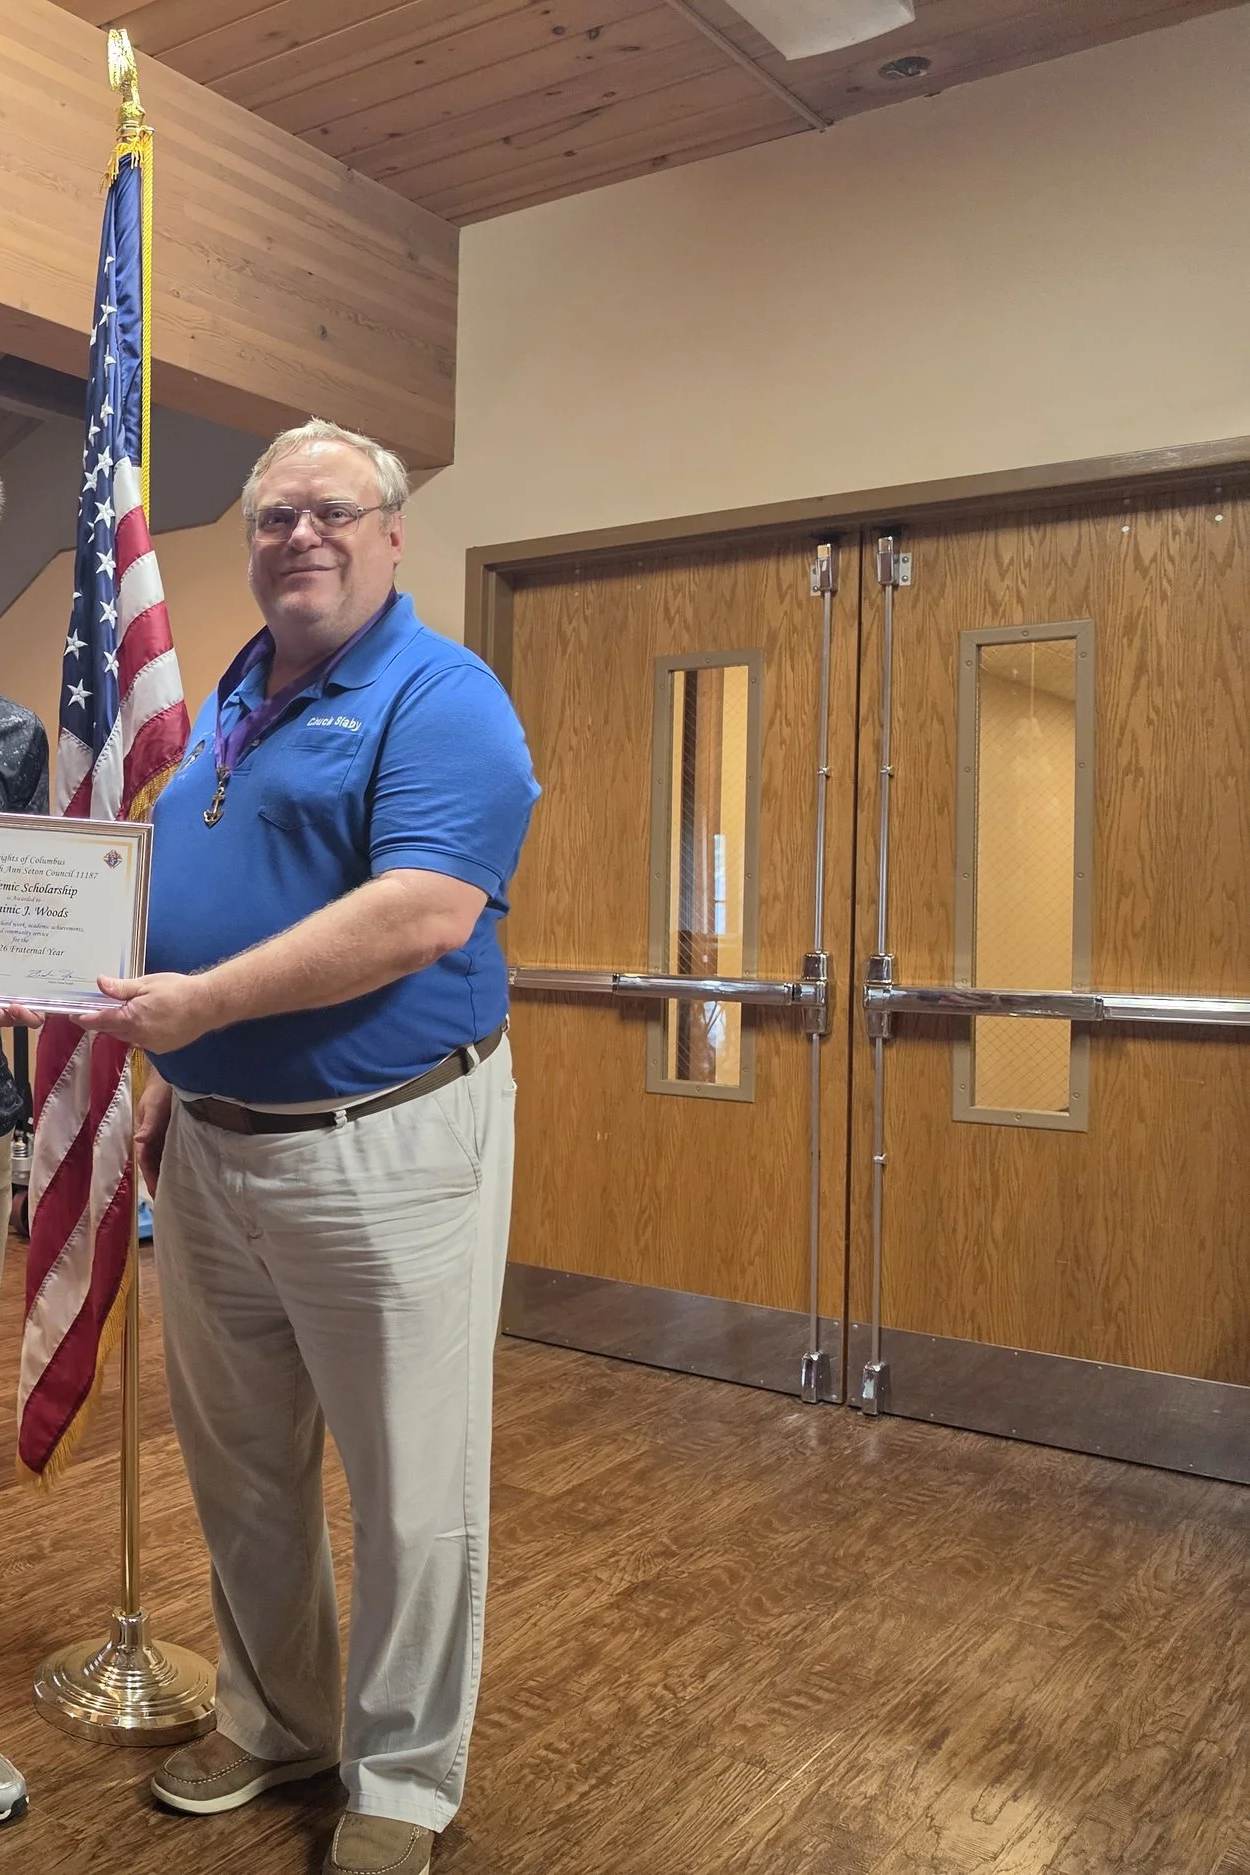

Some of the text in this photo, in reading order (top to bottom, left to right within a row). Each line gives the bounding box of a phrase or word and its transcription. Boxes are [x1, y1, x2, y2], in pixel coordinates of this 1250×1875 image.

[20, 855, 30, 865] of
[30, 856, 66, 865] Columbus
[3, 865, 21, 873] Ann
[22, 867, 44, 875] Seton
[45, 869, 75, 878] Council
[75, 871, 99, 879] 11187
[20, 882, 78, 898] Scholarship
[21, 905, 30, 916] J.
[34, 906, 69, 919] Woods
[9, 945, 46, 954] Fraternal
[47, 947, 65, 956] Year
